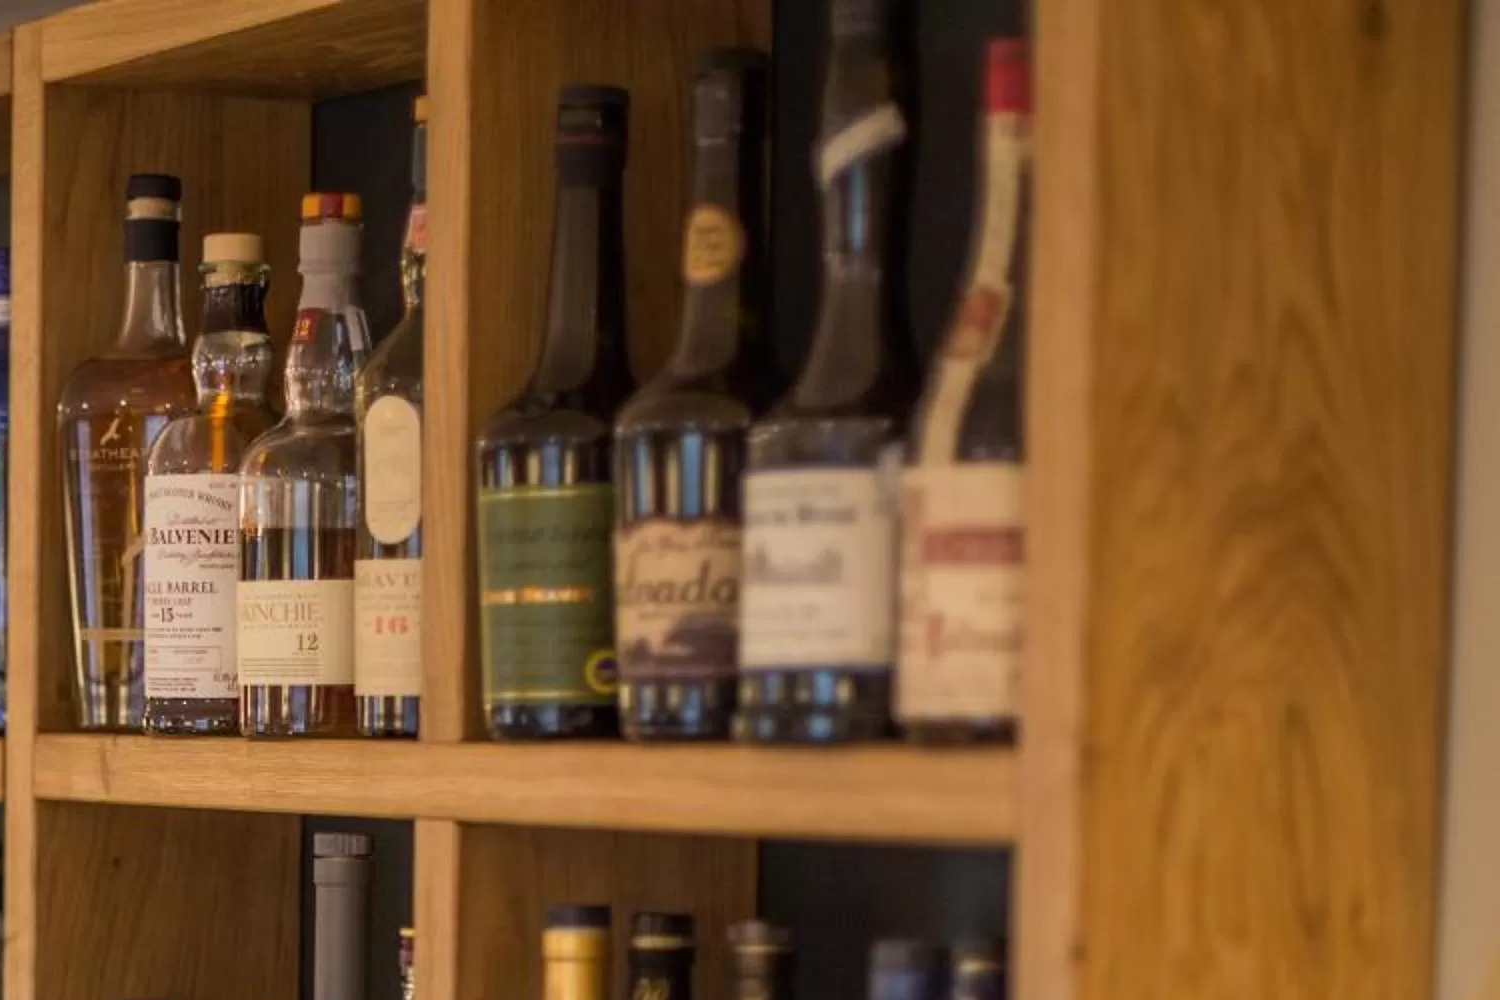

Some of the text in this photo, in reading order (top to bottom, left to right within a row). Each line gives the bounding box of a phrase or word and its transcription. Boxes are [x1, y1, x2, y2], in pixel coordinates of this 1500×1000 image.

[148, 527, 235, 545] BALVENIE
[167, 580, 219, 594] BARREL
[160, 606, 175, 623] 15
[375, 614, 410, 635] 16
[296, 631, 319, 651] 12
